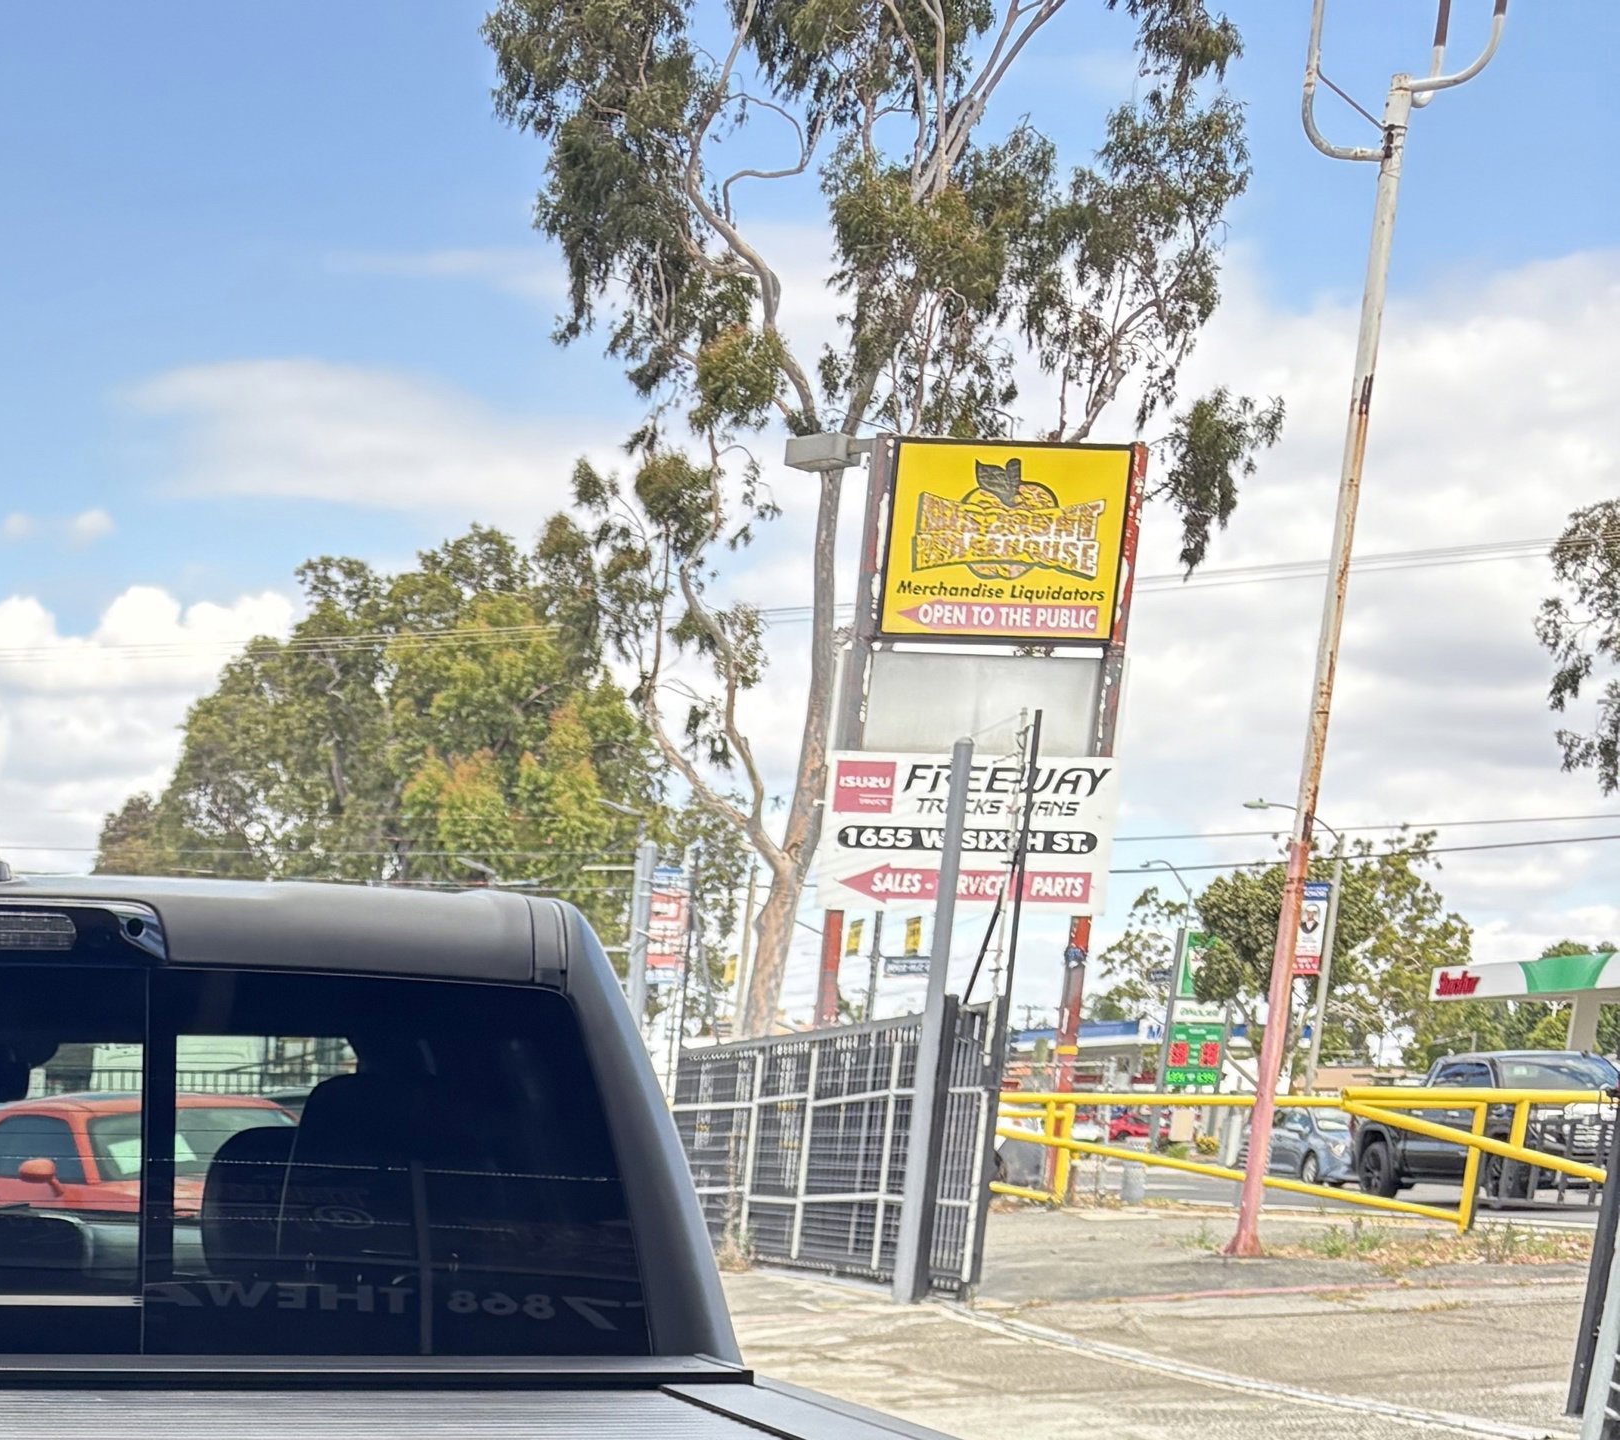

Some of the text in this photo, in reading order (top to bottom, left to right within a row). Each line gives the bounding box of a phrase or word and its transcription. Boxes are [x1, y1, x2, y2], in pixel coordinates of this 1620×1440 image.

[896, 580, 1106, 603] Merchandise Liquidators
[918, 603, 1097, 629] OPEN TO THE PUBLIC
[838, 775, 892, 789] ISUZU
[916, 797, 1004, 815] TRCKS
[845, 827, 914, 847] 1655
[961, 832, 1044, 851] SIXH
[1051, 833, 1090, 852] ST.
[870, 872, 922, 893] SALES
[1030, 876, 1084, 897] PARTS
